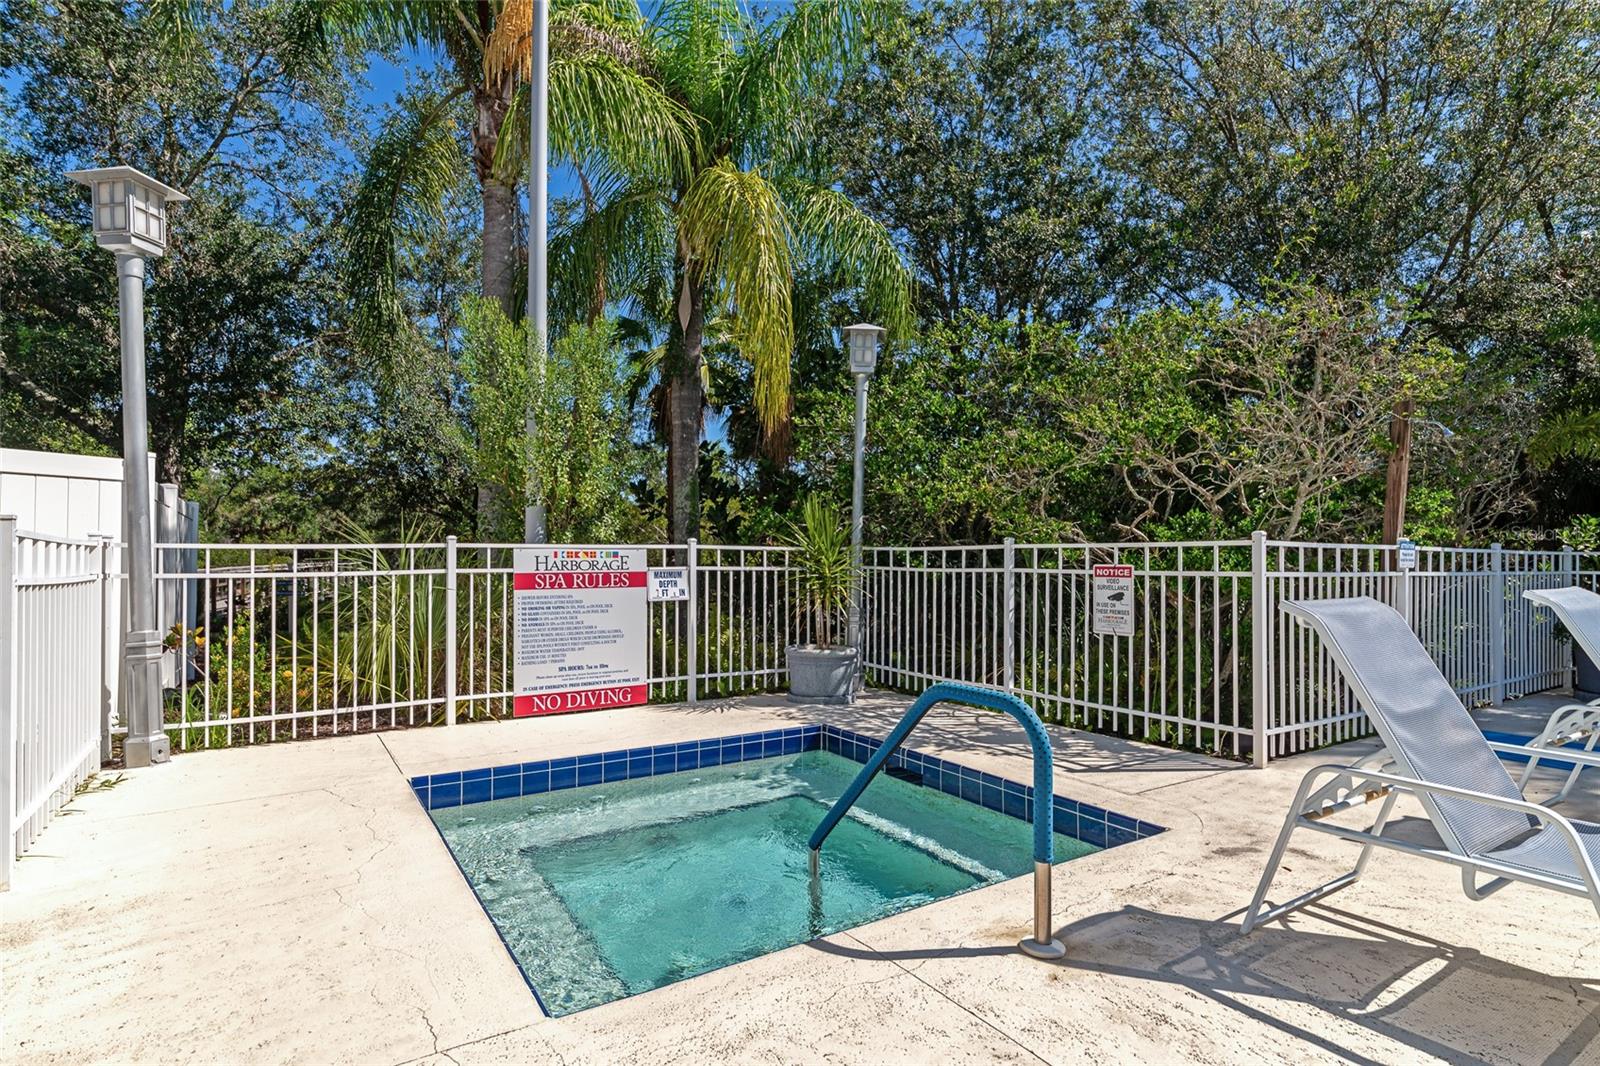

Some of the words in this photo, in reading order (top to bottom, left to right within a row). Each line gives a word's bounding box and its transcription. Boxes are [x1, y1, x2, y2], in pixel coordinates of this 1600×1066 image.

[534, 556, 630, 571] HARBORAGE
[535, 574, 567, 588] SPA
[573, 572, 630, 588] RULES
[659, 580, 678, 588] DEPTH
[662, 588, 668, 596] FT
[679, 588, 685, 596] IN
[532, 694, 561, 712] NO
[566, 688, 632, 708] DIVING
